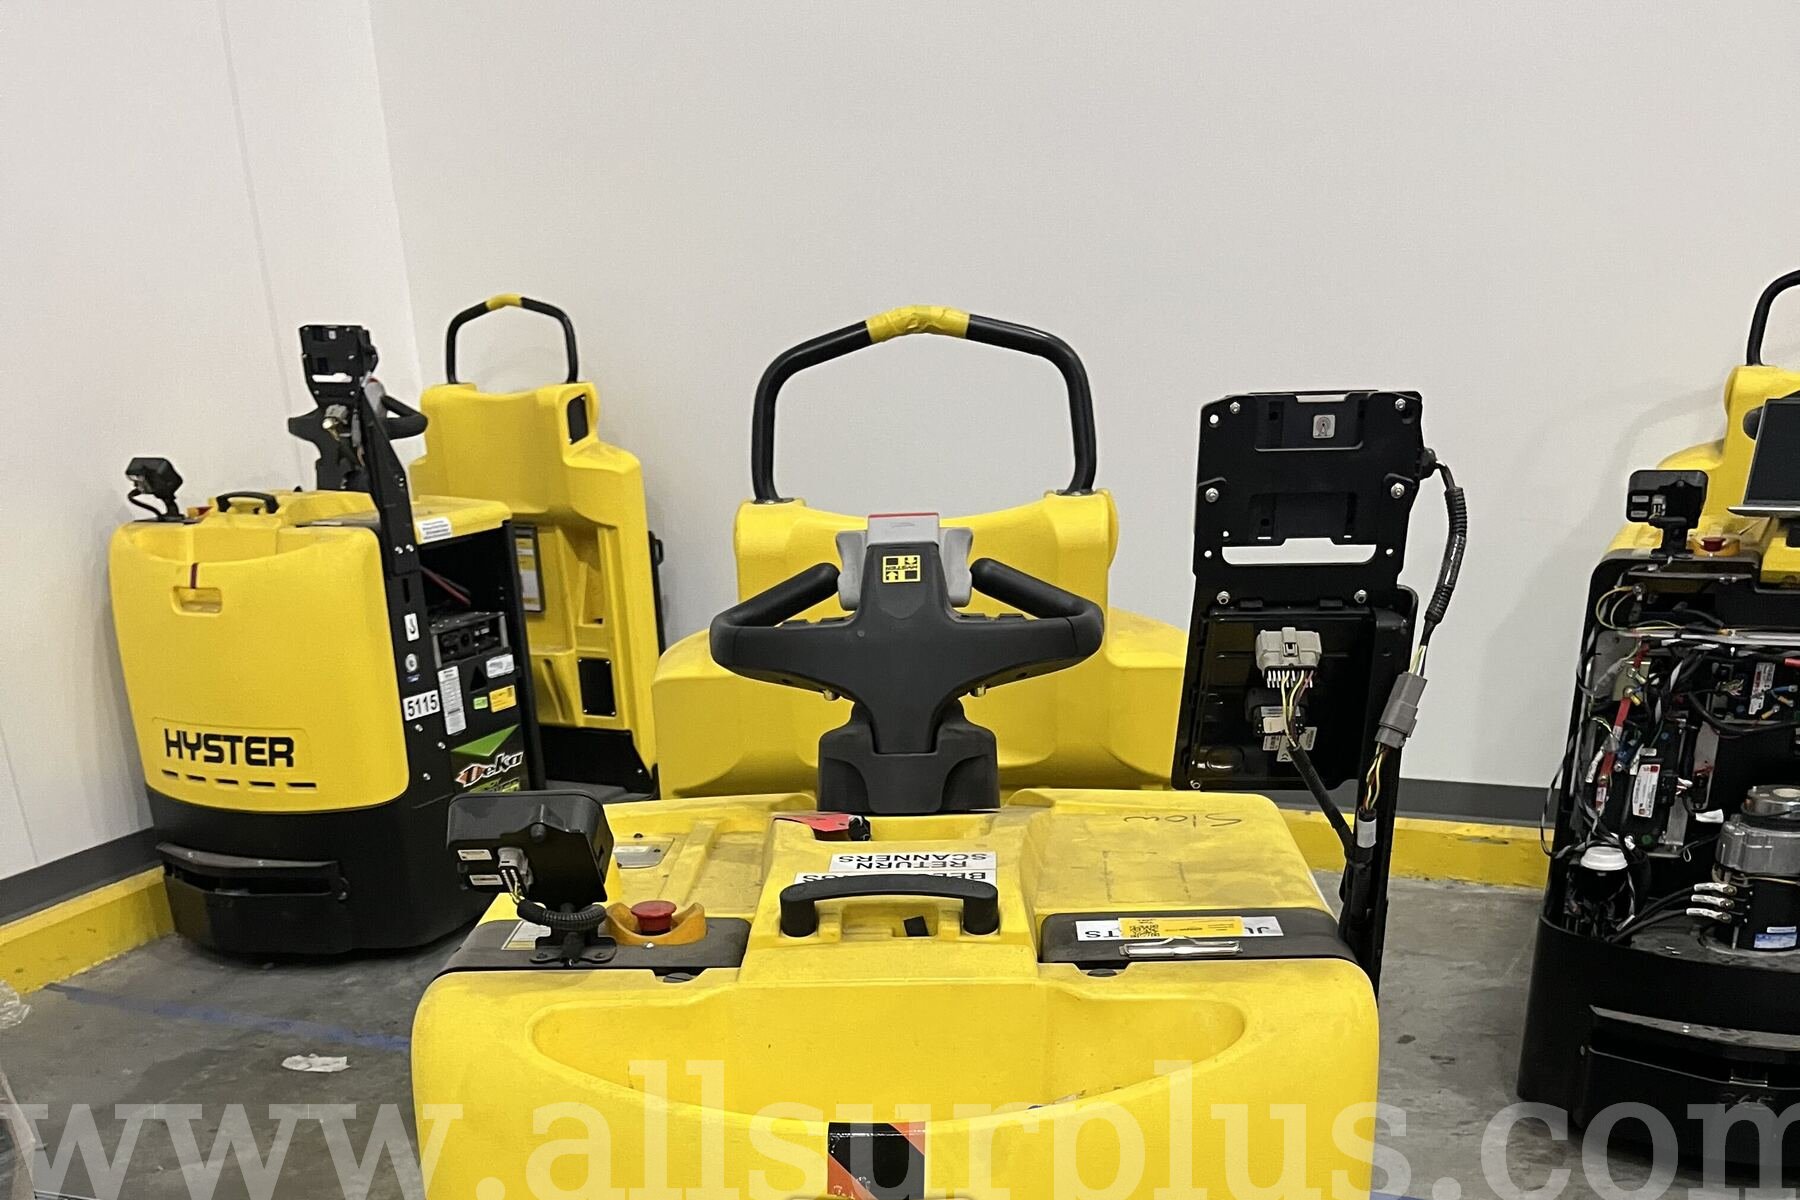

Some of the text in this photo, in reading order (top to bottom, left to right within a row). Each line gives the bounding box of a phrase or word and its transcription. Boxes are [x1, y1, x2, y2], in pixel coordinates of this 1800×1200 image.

[407, 694, 438, 717] 5115
[164, 728, 294, 768] HYSTER
[455, 751, 523, 788] Deka
[838, 853, 988, 863] SCANNERS
[856, 860, 967, 869] RETURN
